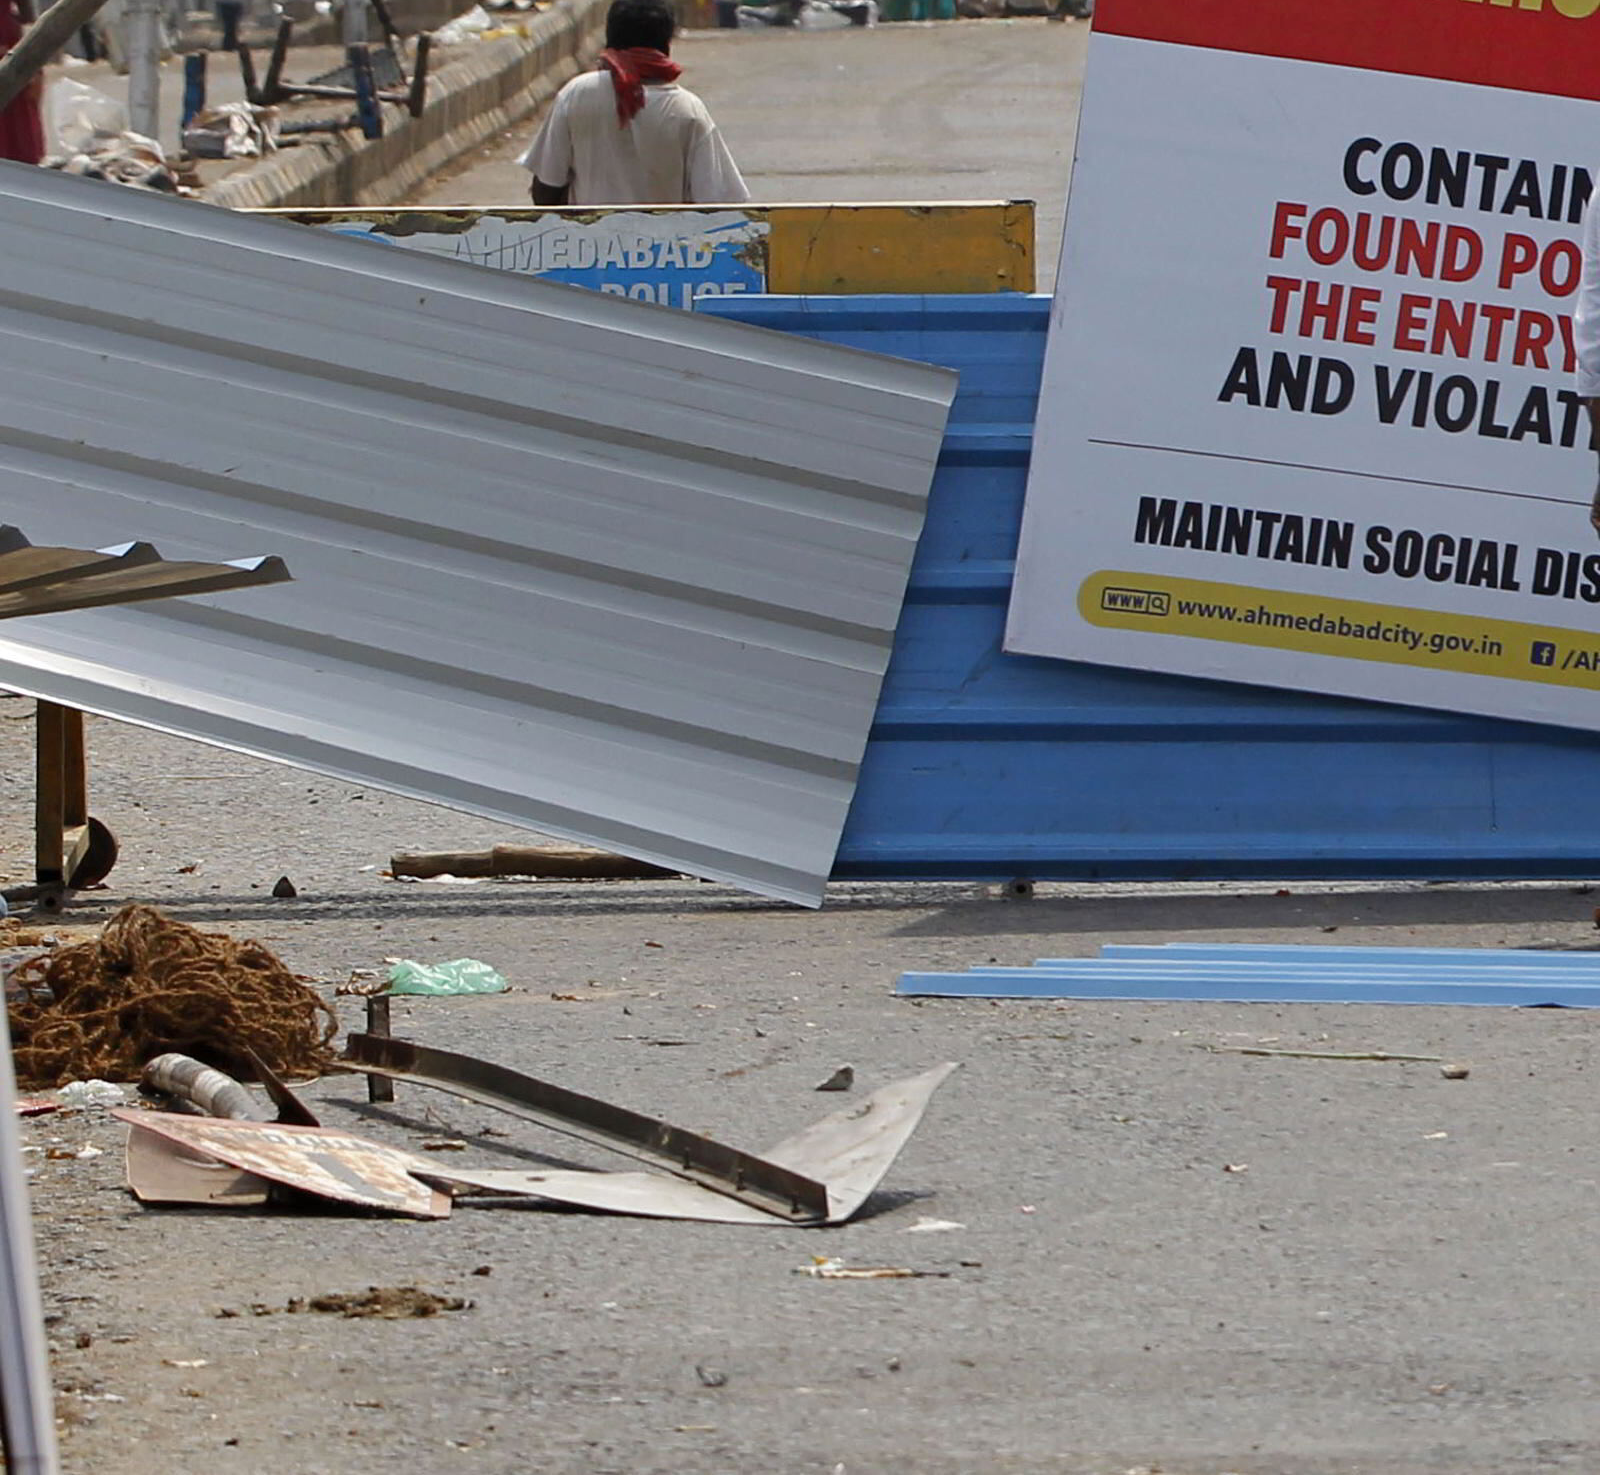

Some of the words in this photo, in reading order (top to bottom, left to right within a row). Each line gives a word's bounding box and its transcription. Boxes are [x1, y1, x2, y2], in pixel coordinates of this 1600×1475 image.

[454, 231, 713, 271] AHMEDABAD
[1269, 201, 1484, 283] FOUND
[1265, 274, 1383, 347] THE
[1217, 346, 1355, 416] AND
[1134, 496, 1355, 570] MAINTAIN
[1363, 526, 1521, 593] SOCIAL
[1177, 596, 1503, 659] www.ahmedabadcity.gov.in
